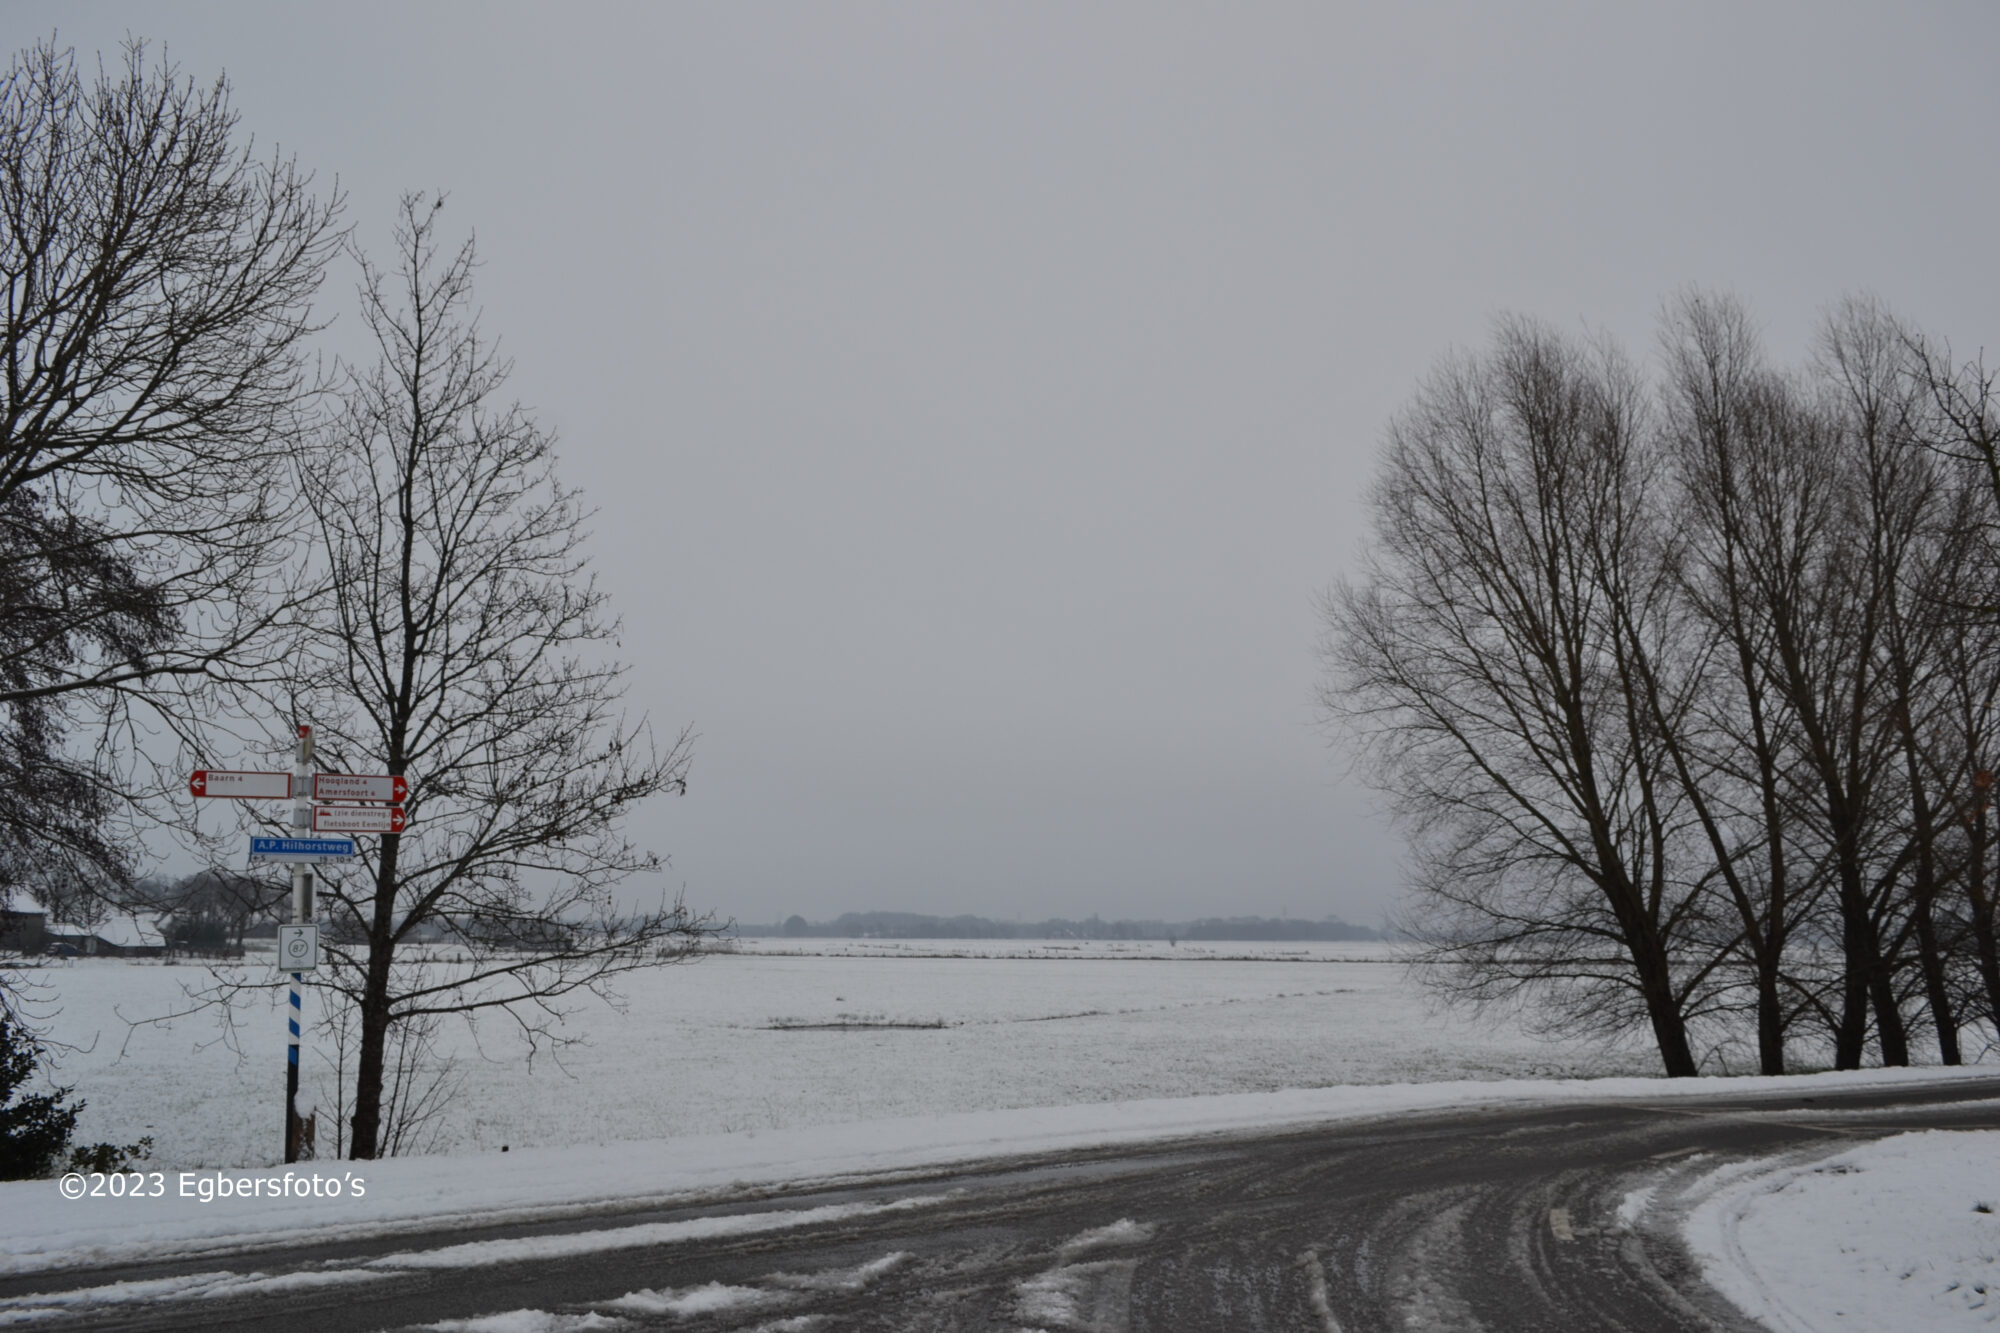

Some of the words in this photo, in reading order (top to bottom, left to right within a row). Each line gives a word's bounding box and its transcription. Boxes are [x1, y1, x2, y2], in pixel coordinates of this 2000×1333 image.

[208, 773, 235, 782] Baarn
[318, 777, 360, 786] Hoogland
[319, 787, 369, 797] Amersfoort
[323, 820, 360, 828] fietsboot
[258, 840, 279, 850] A.P.
[282, 841, 349, 854] Hilhorstweg
[292, 944, 305, 953] 87
